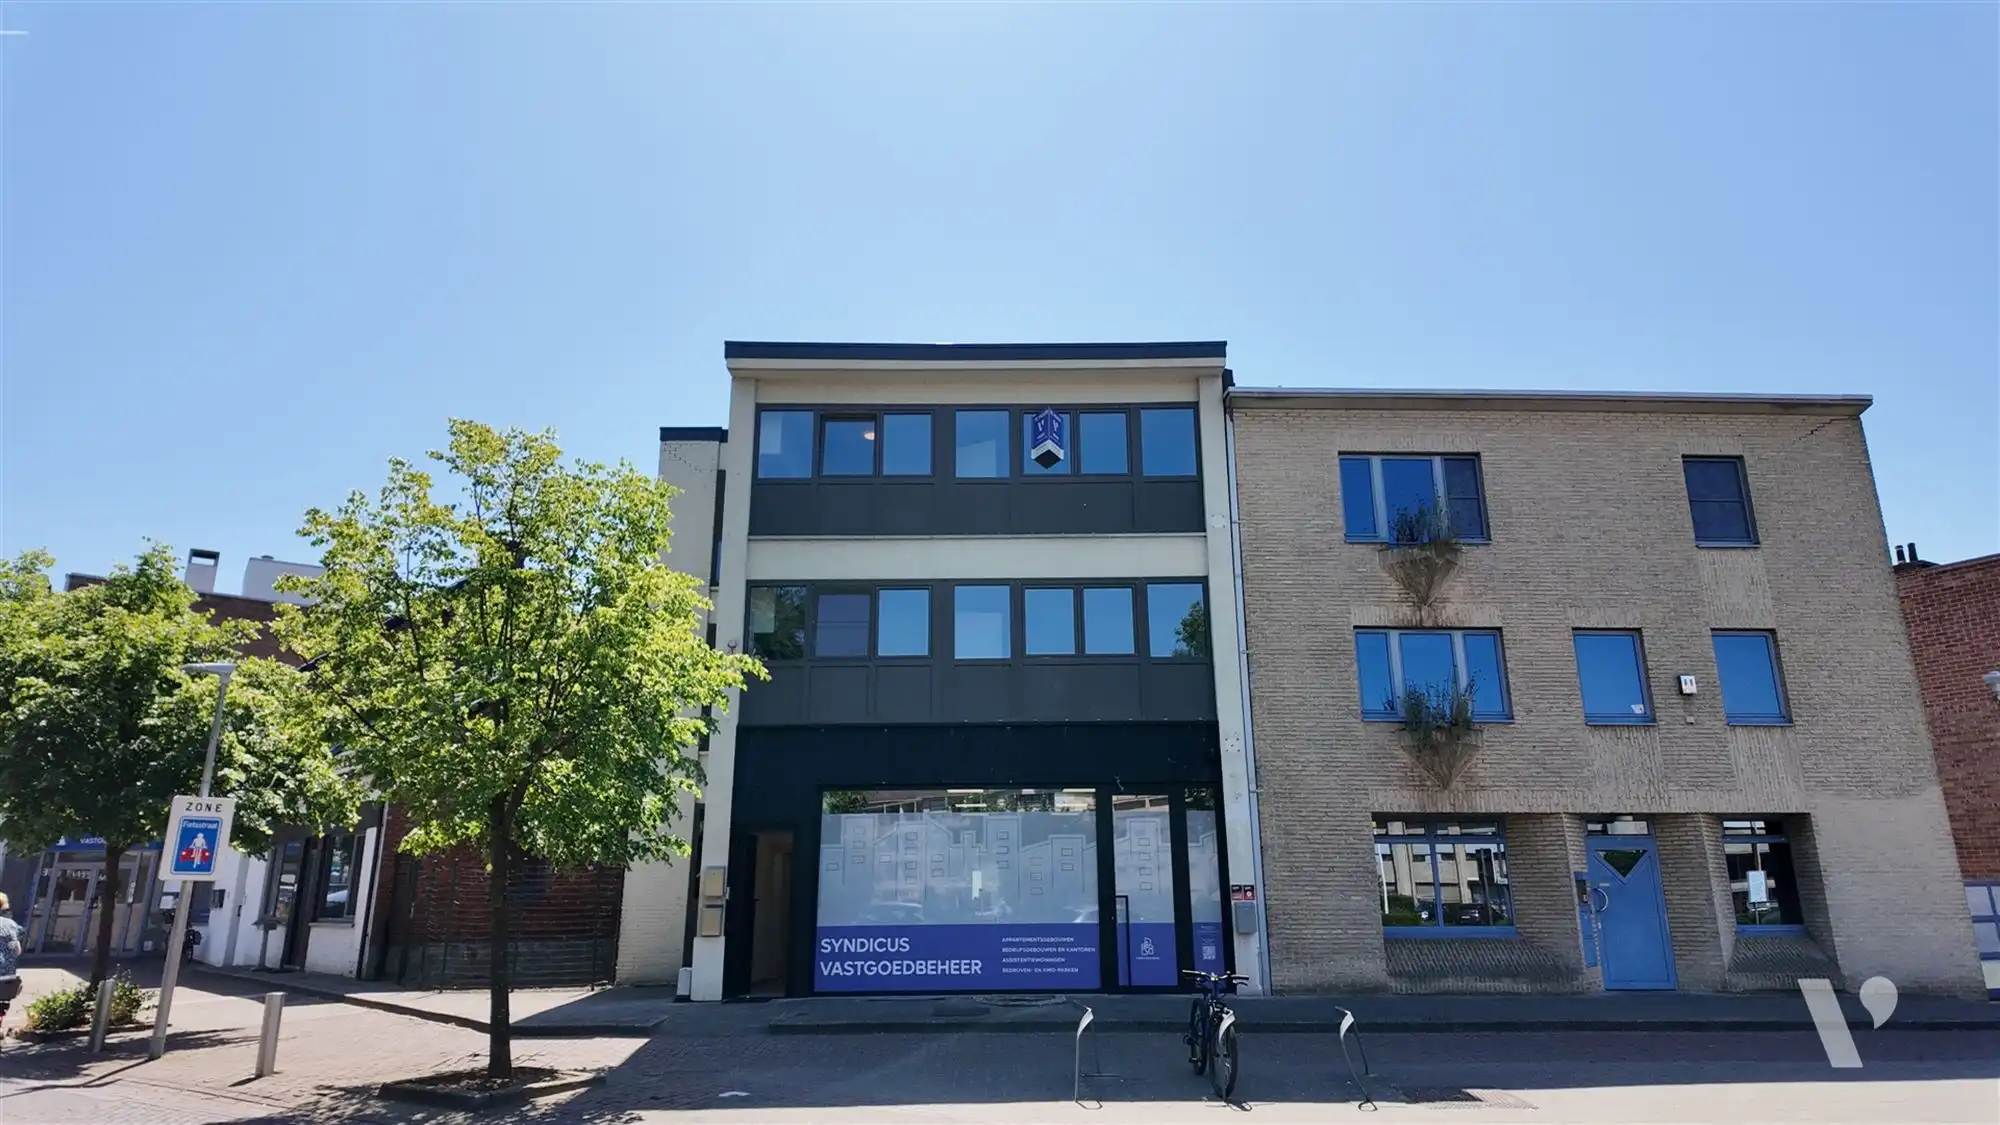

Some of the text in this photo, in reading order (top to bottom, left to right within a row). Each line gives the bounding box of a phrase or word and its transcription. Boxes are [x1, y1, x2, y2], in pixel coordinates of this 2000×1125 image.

[185, 801, 224, 813] ZONE
[182, 820, 218, 829] Fietsstraat
[820, 937, 910, 953] SYNDICUS
[820, 959, 982, 976] VASTGOEDBEHEER
